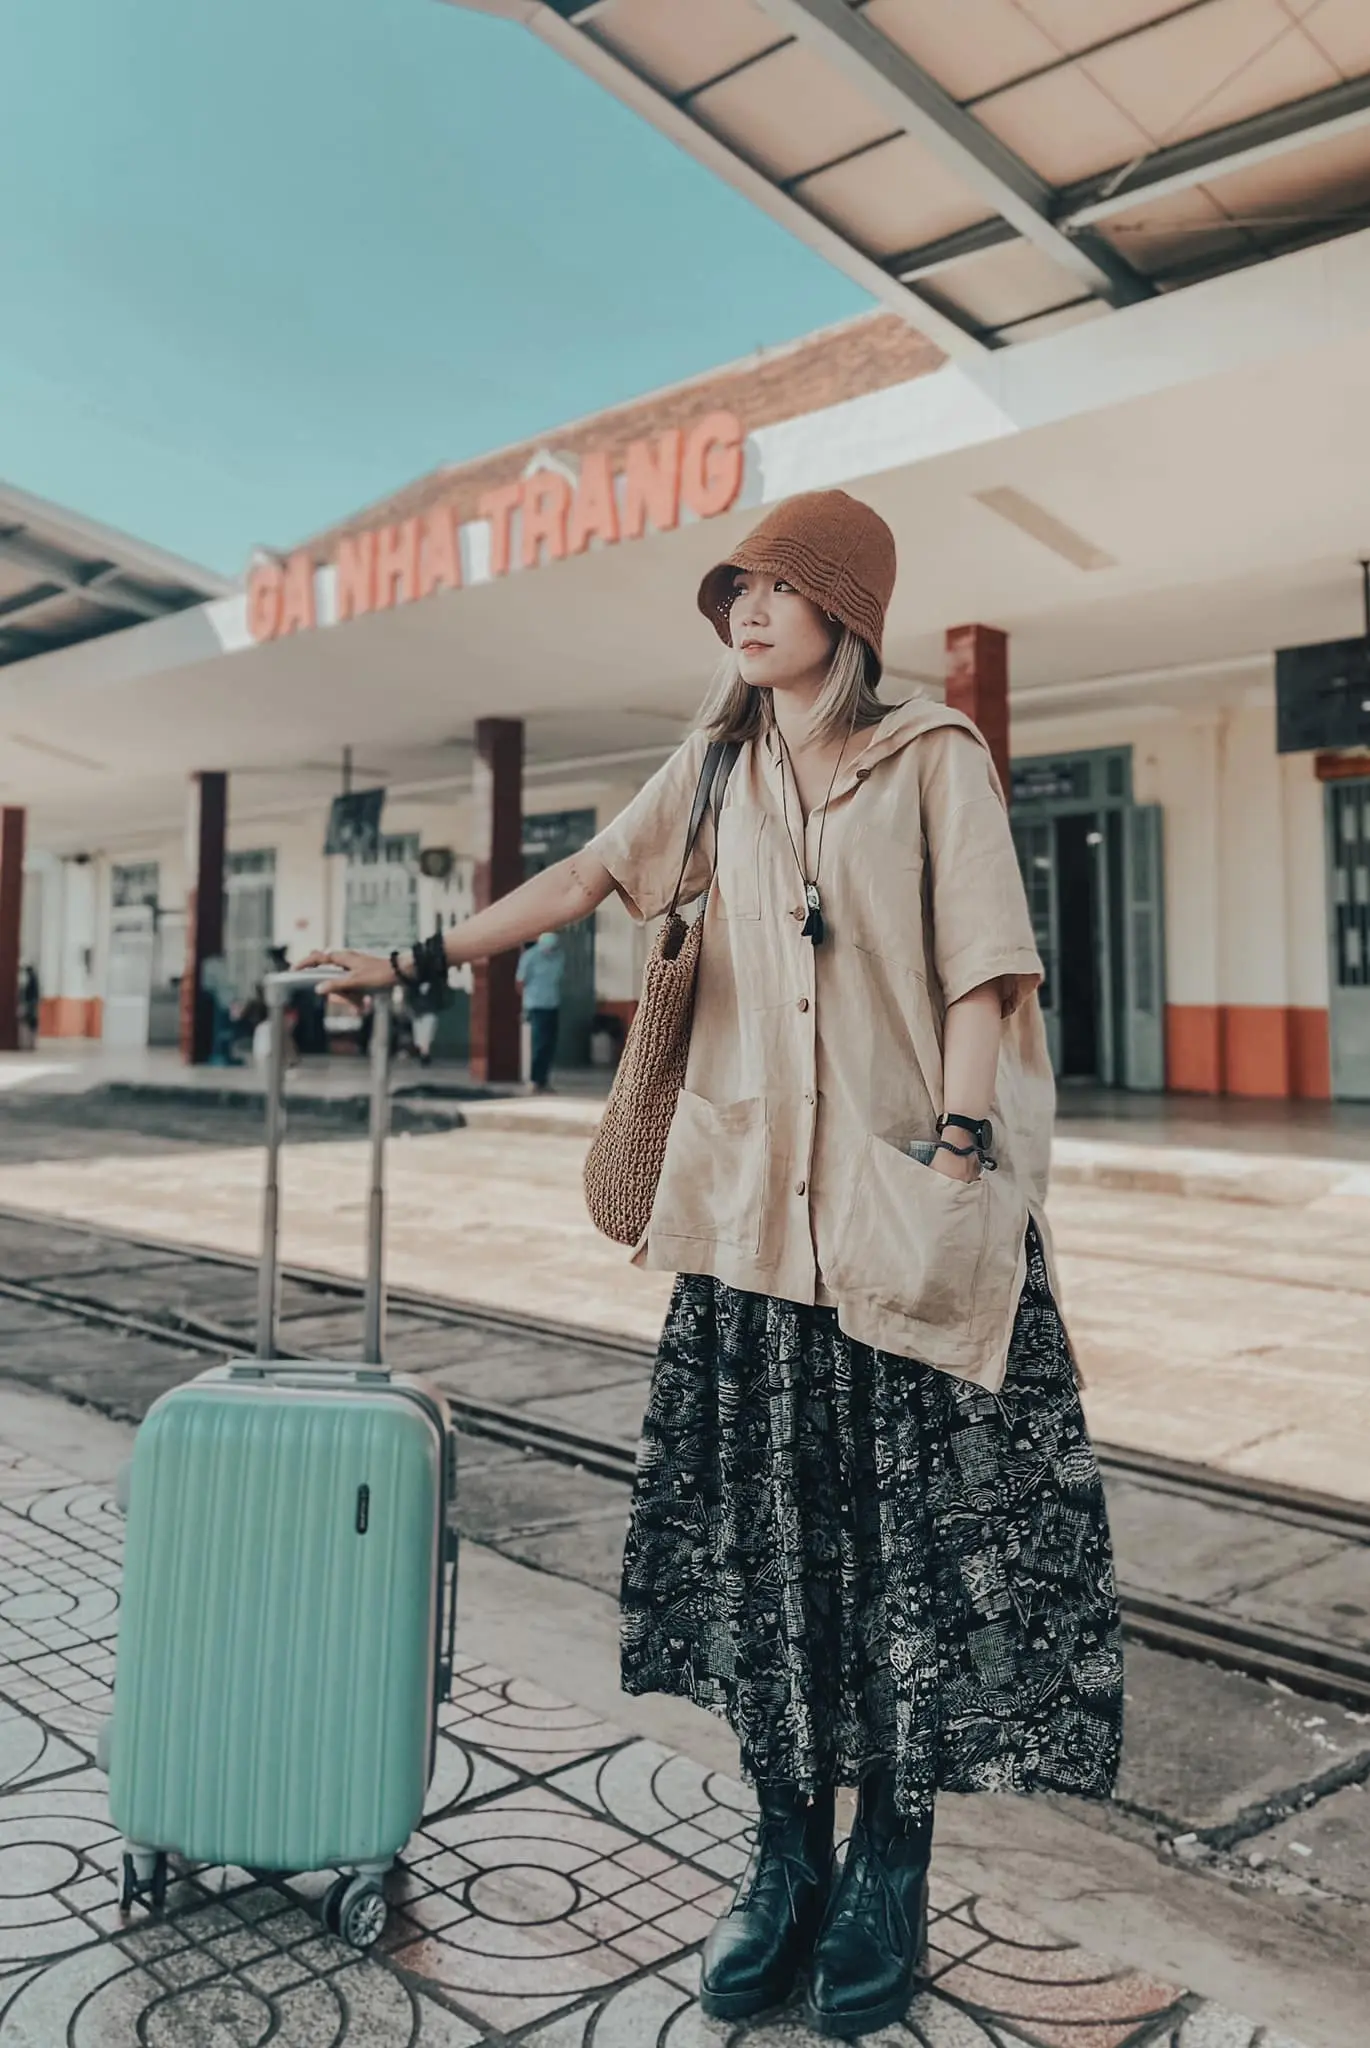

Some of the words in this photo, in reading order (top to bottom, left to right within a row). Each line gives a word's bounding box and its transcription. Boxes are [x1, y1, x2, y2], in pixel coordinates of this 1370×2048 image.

[247, 551, 316, 642] GA
[338, 504, 463, 621] NHA
[479, 410, 745, 576] TRANG
